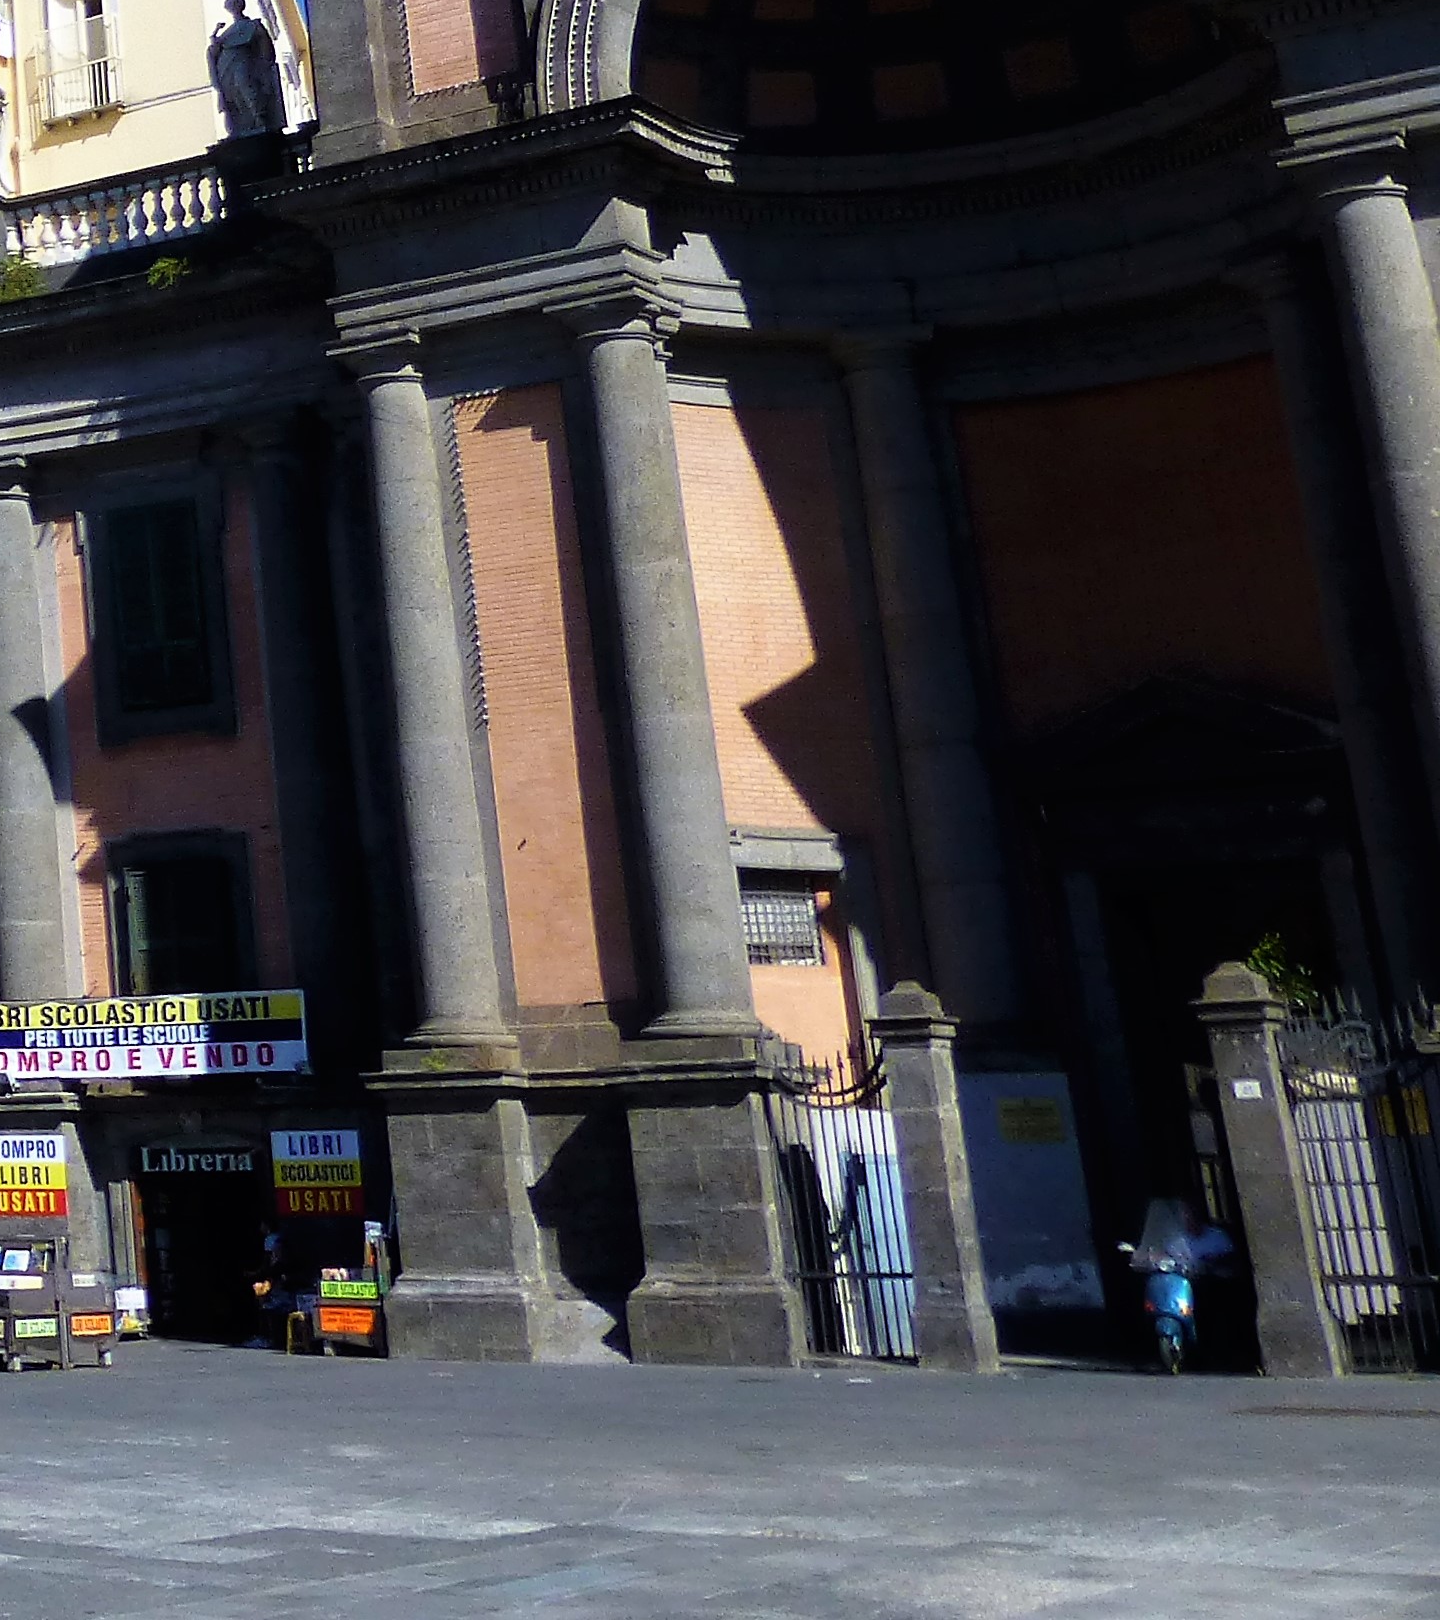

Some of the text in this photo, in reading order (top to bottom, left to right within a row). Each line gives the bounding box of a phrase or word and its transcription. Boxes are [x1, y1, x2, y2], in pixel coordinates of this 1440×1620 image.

[39, 1000, 187, 1026] SCOLASTICI
[197, 996, 271, 1022] USATI
[24, 1025, 211, 1048] PER TUTTE LE SCUOLE
[127, 1048, 142, 1070] E
[158, 1042, 276, 1069] VENDO
[288, 1134, 343, 1156] LIBRI
[140, 1146, 254, 1173] Libreria
[0, 1166, 50, 1186] LIBRI
[280, 1163, 355, 1182] SCOLASTICI
[288, 1189, 353, 1212] USATI
